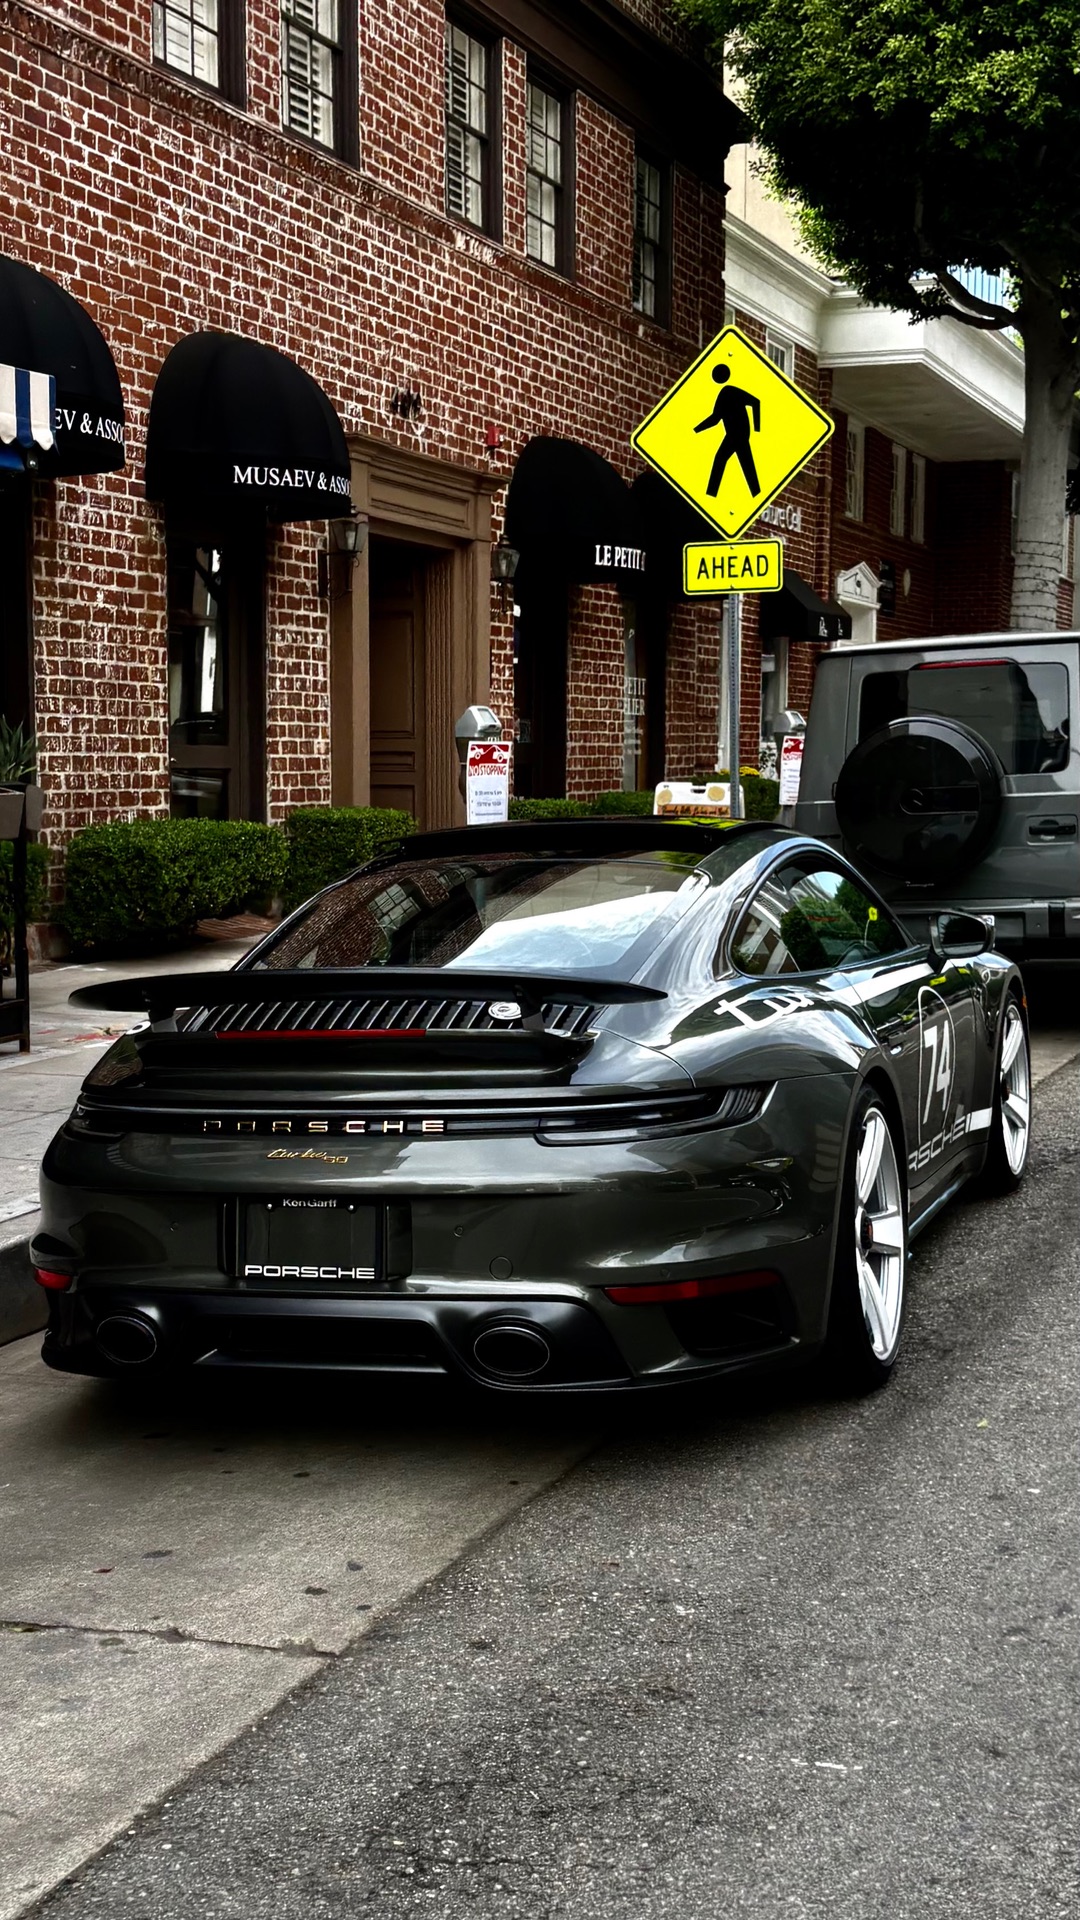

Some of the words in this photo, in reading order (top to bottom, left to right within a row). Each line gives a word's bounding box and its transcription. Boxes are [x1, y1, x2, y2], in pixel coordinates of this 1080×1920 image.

[80, 412, 93, 435] &
[233, 465, 315, 488] MUSAEV
[317, 471, 328, 490] &
[595, 544, 612, 566] LE
[614, 546, 641, 570] PETIT
[696, 554, 769, 580] AHEAD
[468, 764, 479, 777] NO
[480, 764, 507, 776] STOPPING
[923, 1019, 951, 1125] 74
[203, 1119, 445, 1133] PORSCHE
[282, 1198, 306, 1207] Ken
[307, 1198, 337, 1208] Garff
[244, 1264, 376, 1279] PORSCHE
